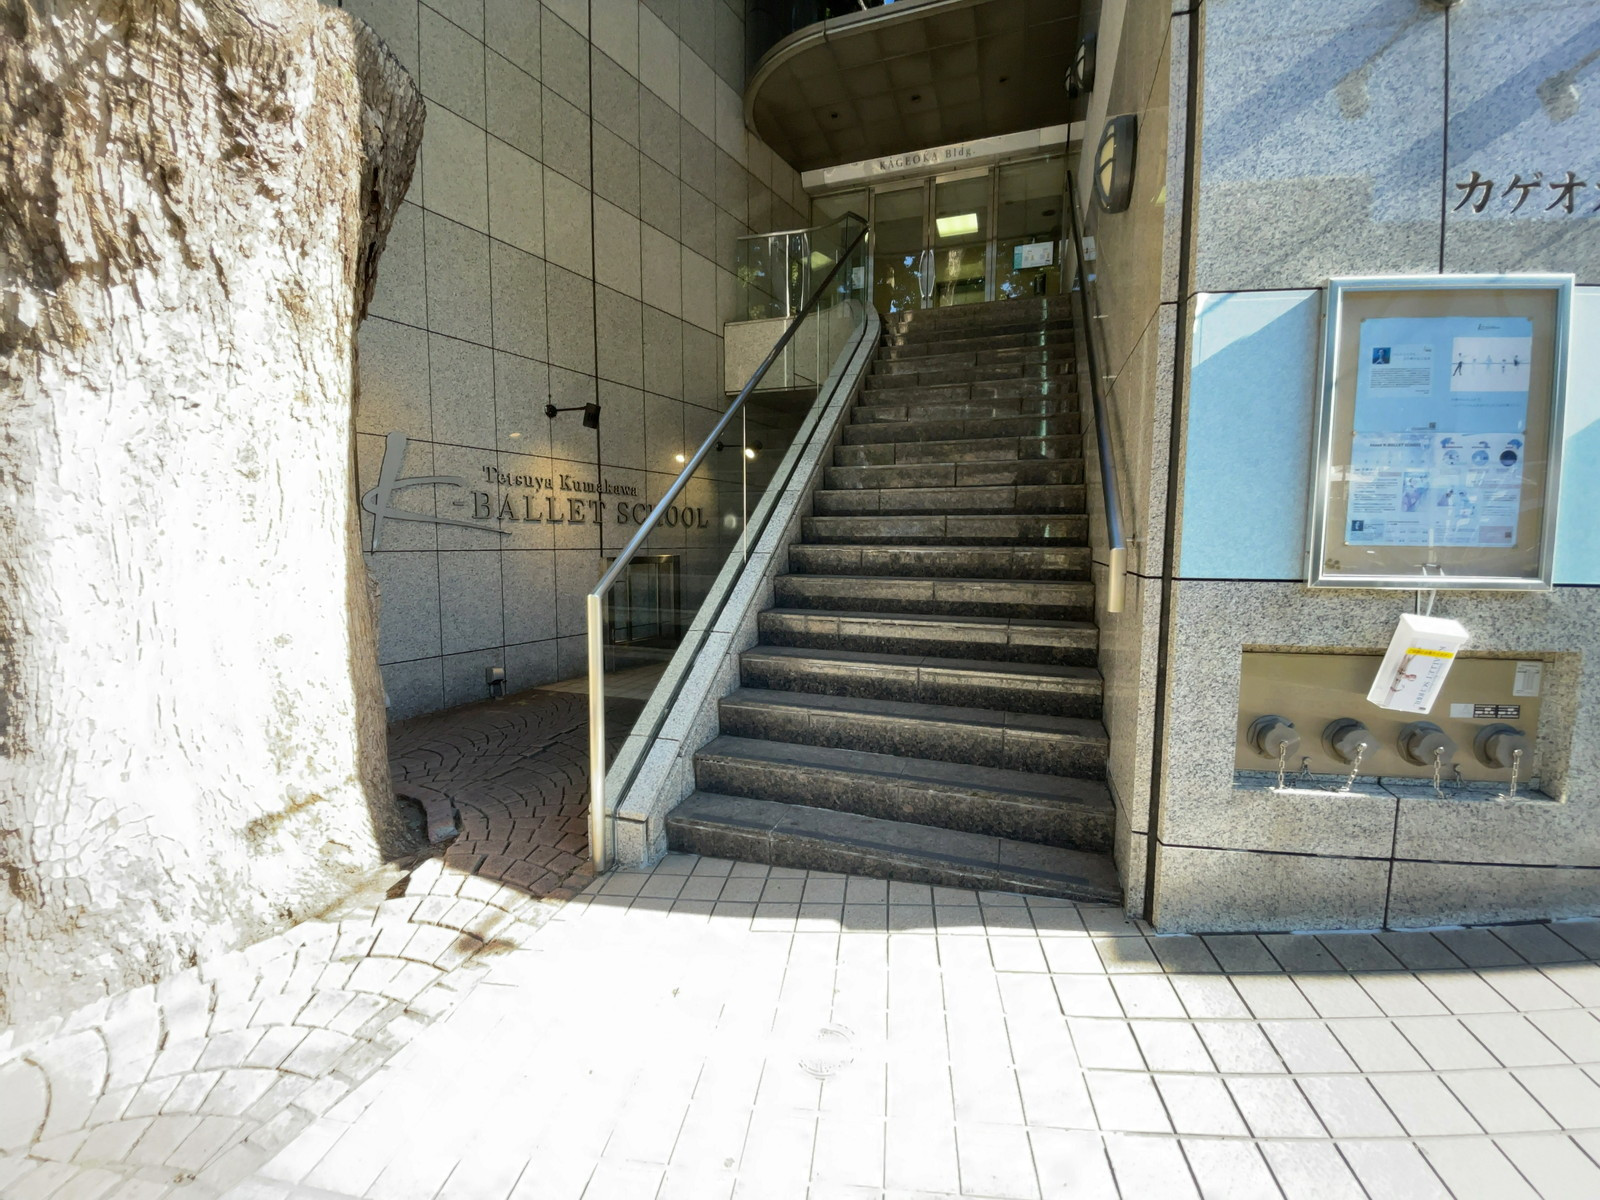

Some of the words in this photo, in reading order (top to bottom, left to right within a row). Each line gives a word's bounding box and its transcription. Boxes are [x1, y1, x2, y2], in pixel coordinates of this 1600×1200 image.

[880, 152, 937, 170] KAGEOKA
[945, 147, 975, 159] Bldg.
[1453, 171, 1600, 214] カゲオ
[482, 466, 553, 492] Tetsuya
[559, 474, 638, 497] Kumakawa
